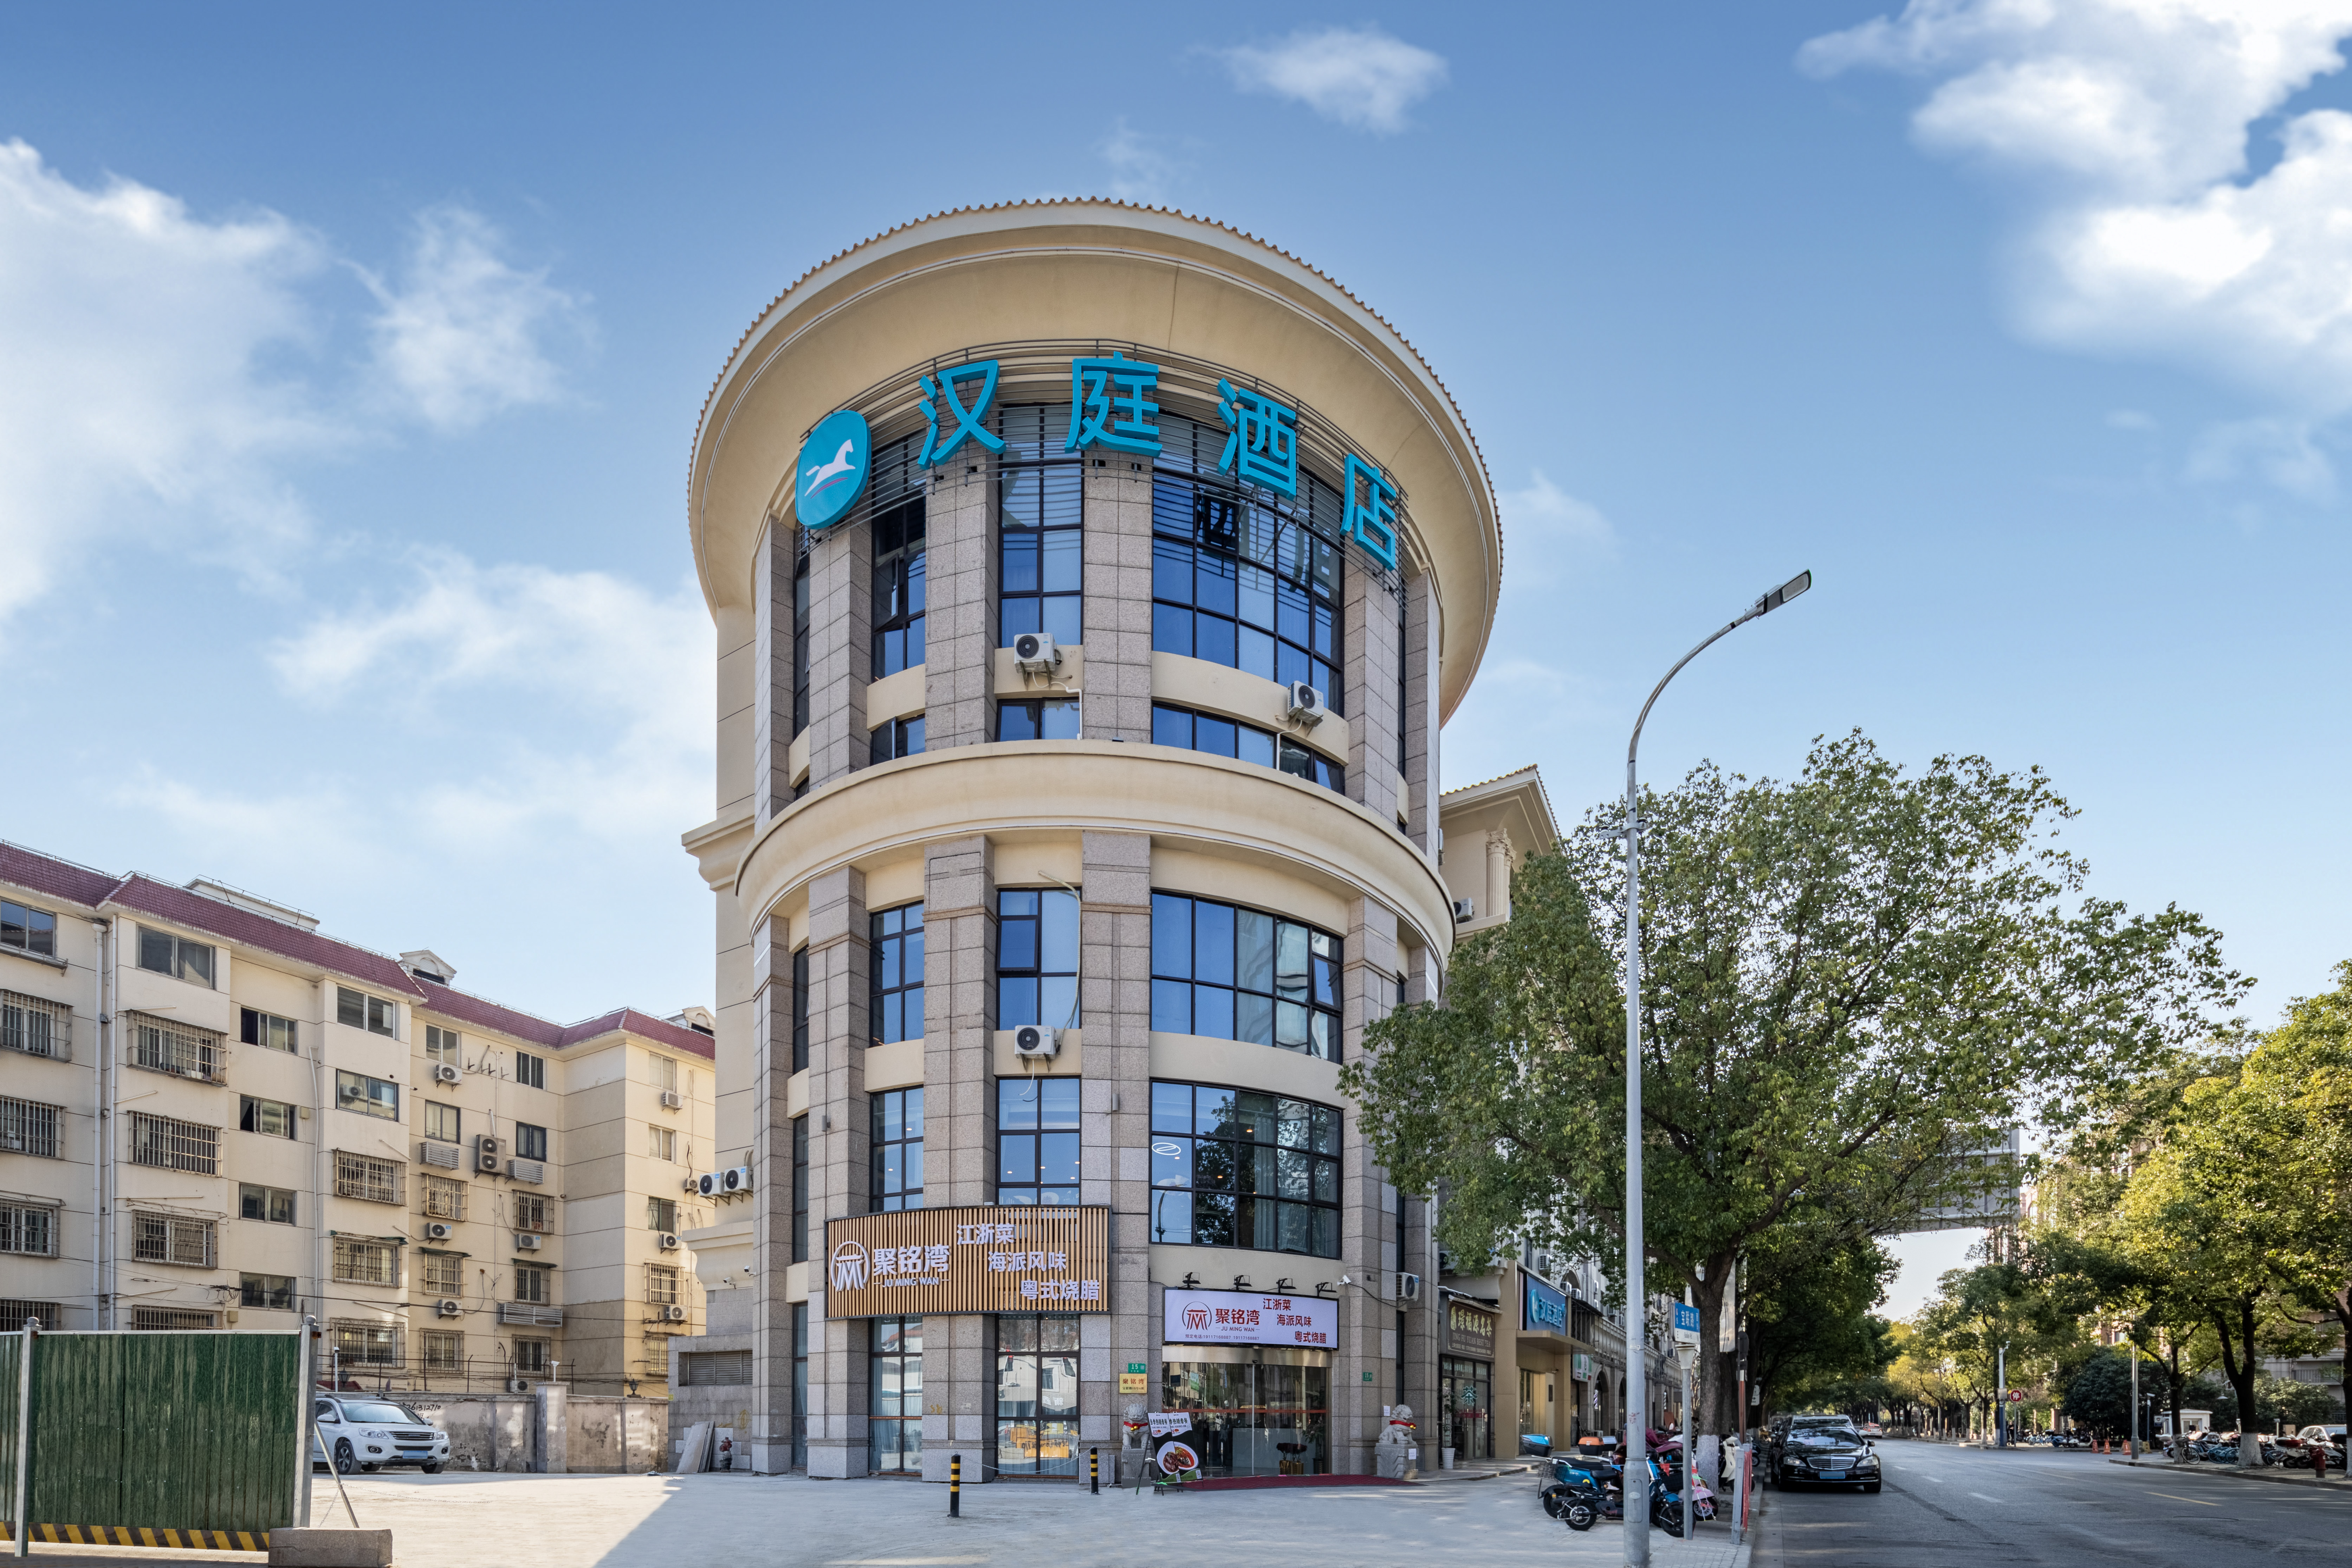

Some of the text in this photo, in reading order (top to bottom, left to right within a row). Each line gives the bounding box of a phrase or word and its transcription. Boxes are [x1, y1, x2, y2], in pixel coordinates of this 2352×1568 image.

[917, 351, 1397, 571] 汉庭酒店
[957, 1223, 1015, 1245] 江浙菜
[874, 1244, 950, 1276] 聚铭湾
[988, 1251, 1067, 1272] 海派风味
[882, 1277, 940, 1287] JU MING WAN
[1021, 1279, 1100, 1300] 粤式烧腊
[1263, 1298, 1291, 1311] 江浙菜
[1216, 1308, 1260, 1325] 聚铭湾
[1277, 1314, 1311, 1327] 海派风味
[1295, 1331, 1327, 1344] 粤式烧腊
[1452, 1332, 1460, 1341] JING
[1467, 1336, 1476, 1344] YUAN
[1461, 1386, 1478, 1405] 茶
[2013, 1392, 2020, 1400] 停
